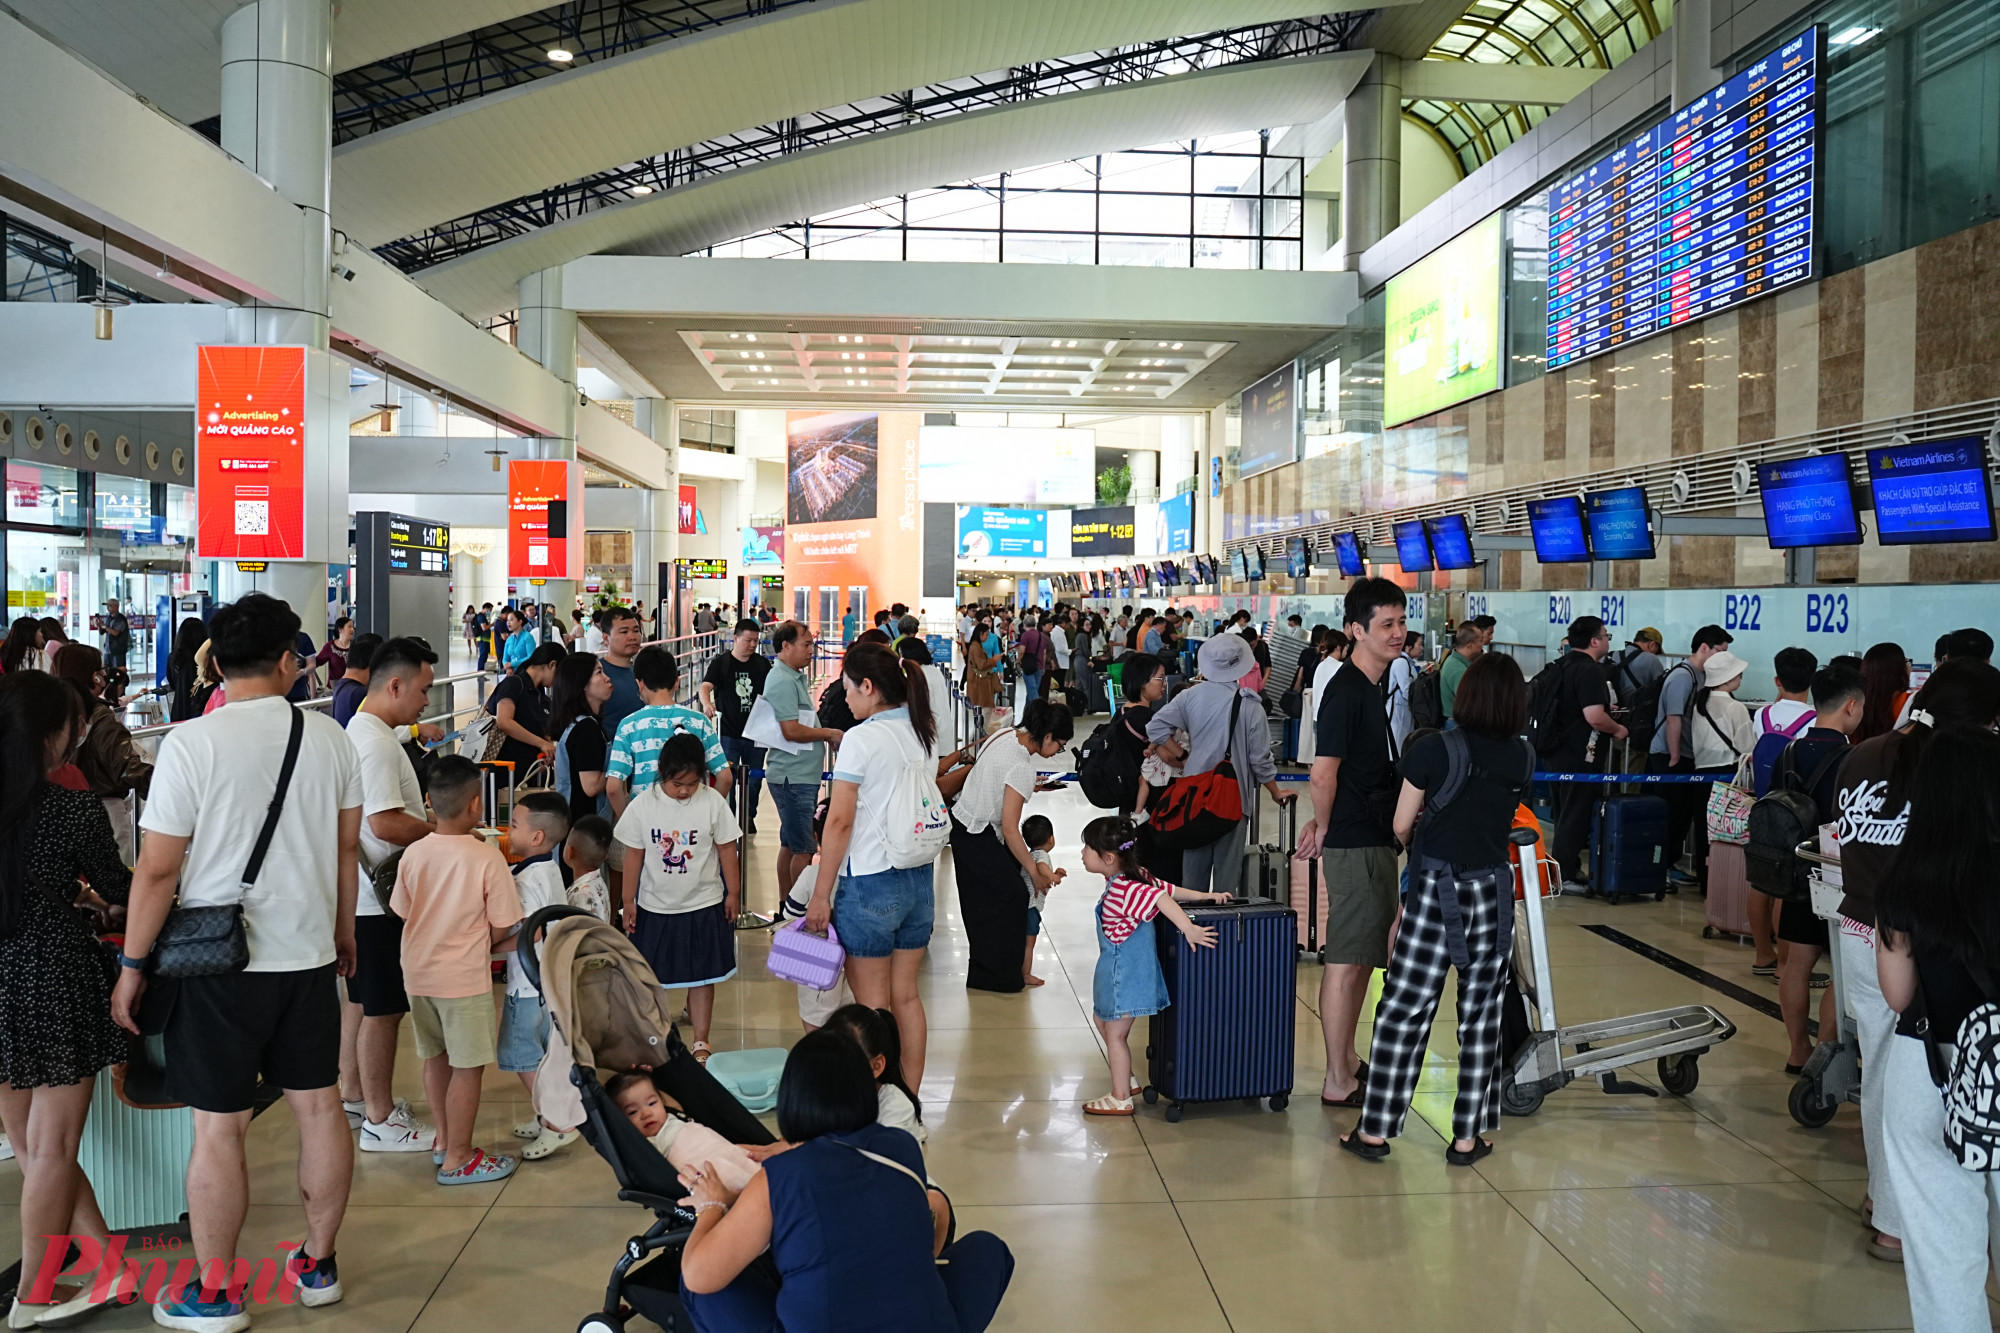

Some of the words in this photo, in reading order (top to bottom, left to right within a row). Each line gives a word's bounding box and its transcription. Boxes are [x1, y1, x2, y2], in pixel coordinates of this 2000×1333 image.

[1748, 74, 1766, 92] Check-in
[1782, 53, 1801, 71] Remark
[1786, 67, 1806, 86] Check-in
[1786, 84, 1806, 103] Check-in
[1786, 101, 1806, 119] Check-in
[1785, 119, 1805, 136] Check-in
[1785, 136, 1805, 153] Check-in
[1785, 153, 1805, 170] Check-in
[1784, 171, 1804, 187] Check-in
[1784, 187, 1804, 203] Check-in
[1784, 205, 1804, 220] Check-in
[1784, 221, 1803, 236] Check-in
[1783, 237, 1803, 251] Check-in
[1783, 252, 1802, 266] Check-in
[1782, 267, 1802, 281] Check-in
[222, 411, 279, 421] Advertising
[207, 424, 228, 434] MỜI
[230, 424, 269, 436] QUẢNG
[271, 424, 295, 435] CÁO
[900, 440, 918, 480] place
[1893, 457, 1925, 468] Vietnam
[1925, 453, 1955, 465] Airlines
[1212, 456, 1223, 498] B
[1780, 470, 1802, 480] Vietnam
[1802, 468, 1824, 477] Airlines
[1879, 488, 1898, 500] KHÁCH
[1898, 486, 1912, 500] CẦN
[1920, 486, 1933, 500] TRỢ
[1934, 484, 1949, 496] GIÚP
[1949, 482, 1962, 497] ĐẶC
[1964, 480, 1977, 496] BIỆT
[1777, 501, 1796, 513] HẠNG
[1810, 496, 1836, 508] THÔNG
[1881, 506, 1912, 517] Passengers
[1911, 503, 1926, 514] With
[1926, 501, 1946, 515] Special
[1948, 501, 1980, 511] Assistance
[1785, 513, 1814, 524] Economy
[1814, 511, 1831, 521] Class
[423, 527, 436, 546] 1-17
[1110, 525, 1124, 538] 1-12
[1409, 596, 1423, 620] B18
[1470, 596, 1486, 620] B19
[1550, 596, 1570, 624] B20
[1601, 596, 1624, 626] B21
[1724, 594, 1762, 630] B22
[1806, 593, 1850, 633] B23
[1838, 800, 1912, 846] Studi
